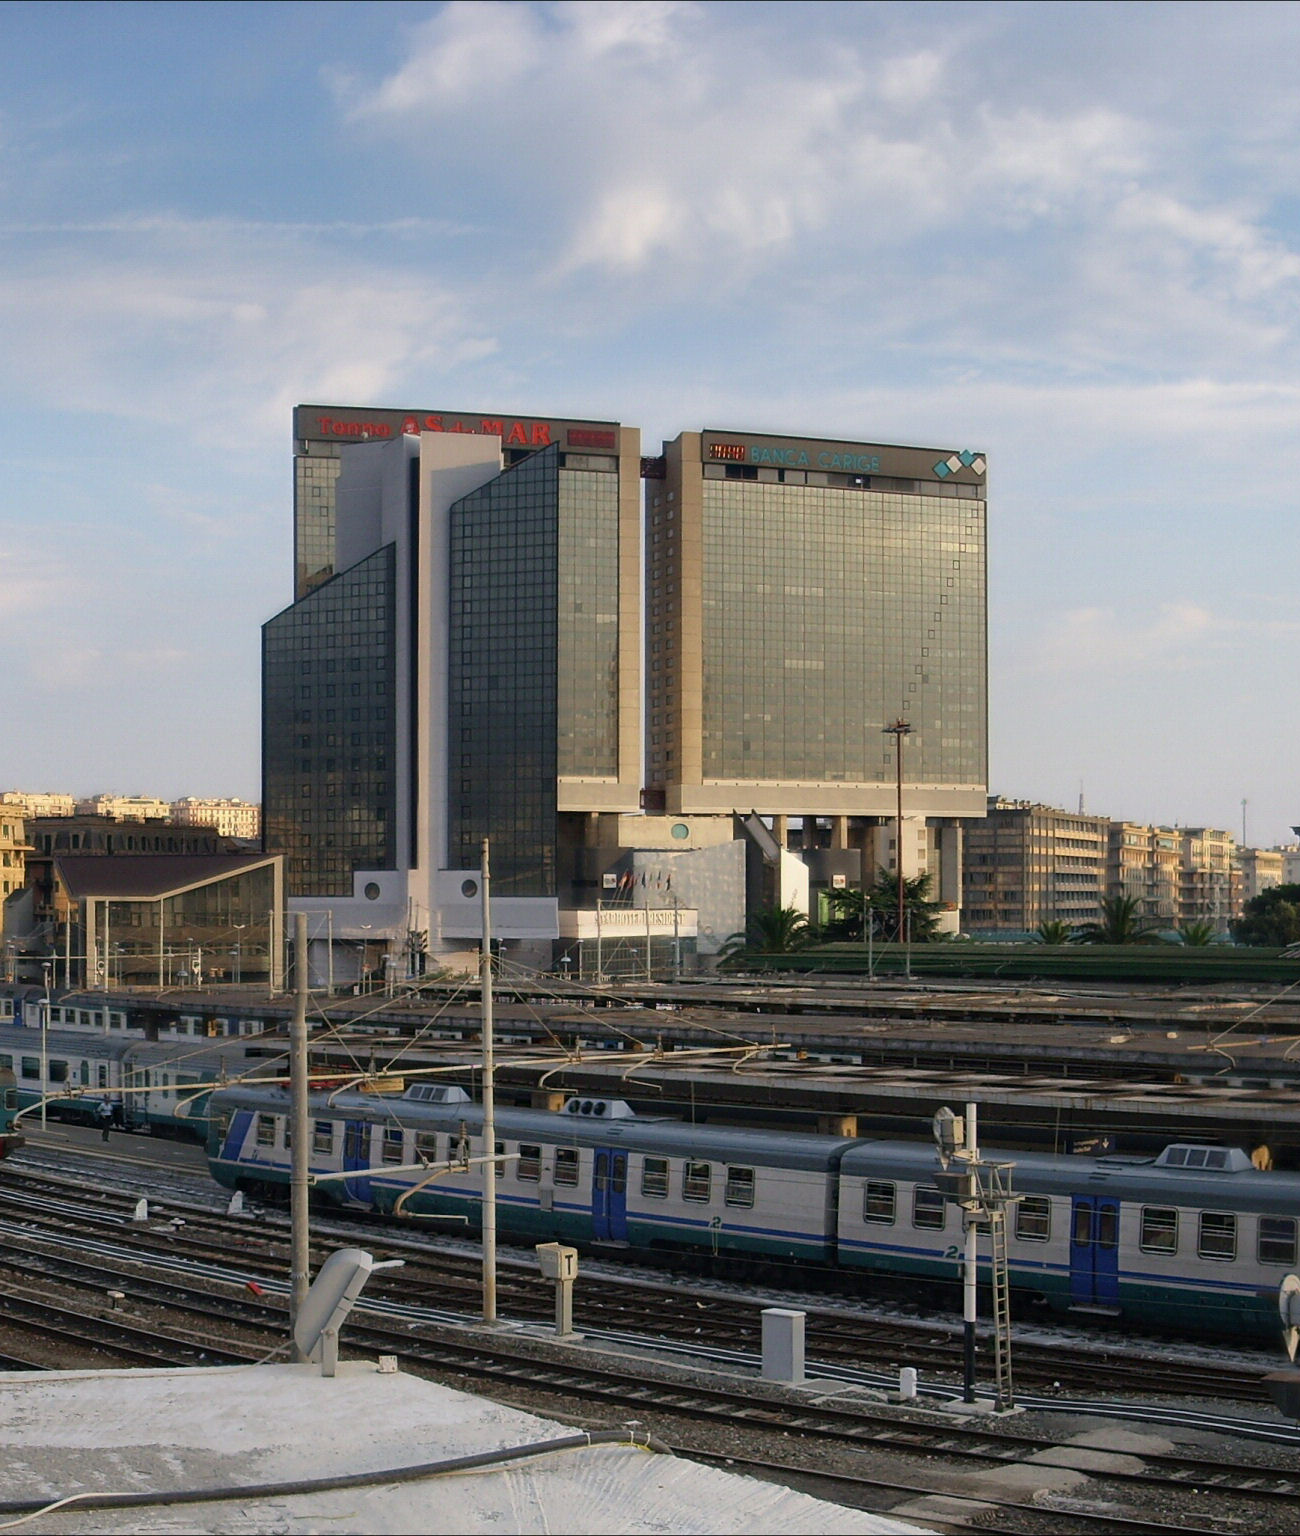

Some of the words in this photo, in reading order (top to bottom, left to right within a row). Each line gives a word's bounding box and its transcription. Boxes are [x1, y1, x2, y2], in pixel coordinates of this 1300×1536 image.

[316, 416, 391, 438] Tonno
[481, 420, 551, 445] MAR
[751, 446, 809, 466] BANCA
[818, 451, 880, 472] CARIGE
[945, 1245, 958, 1258] 2
[564, 1254, 574, 1276] T
